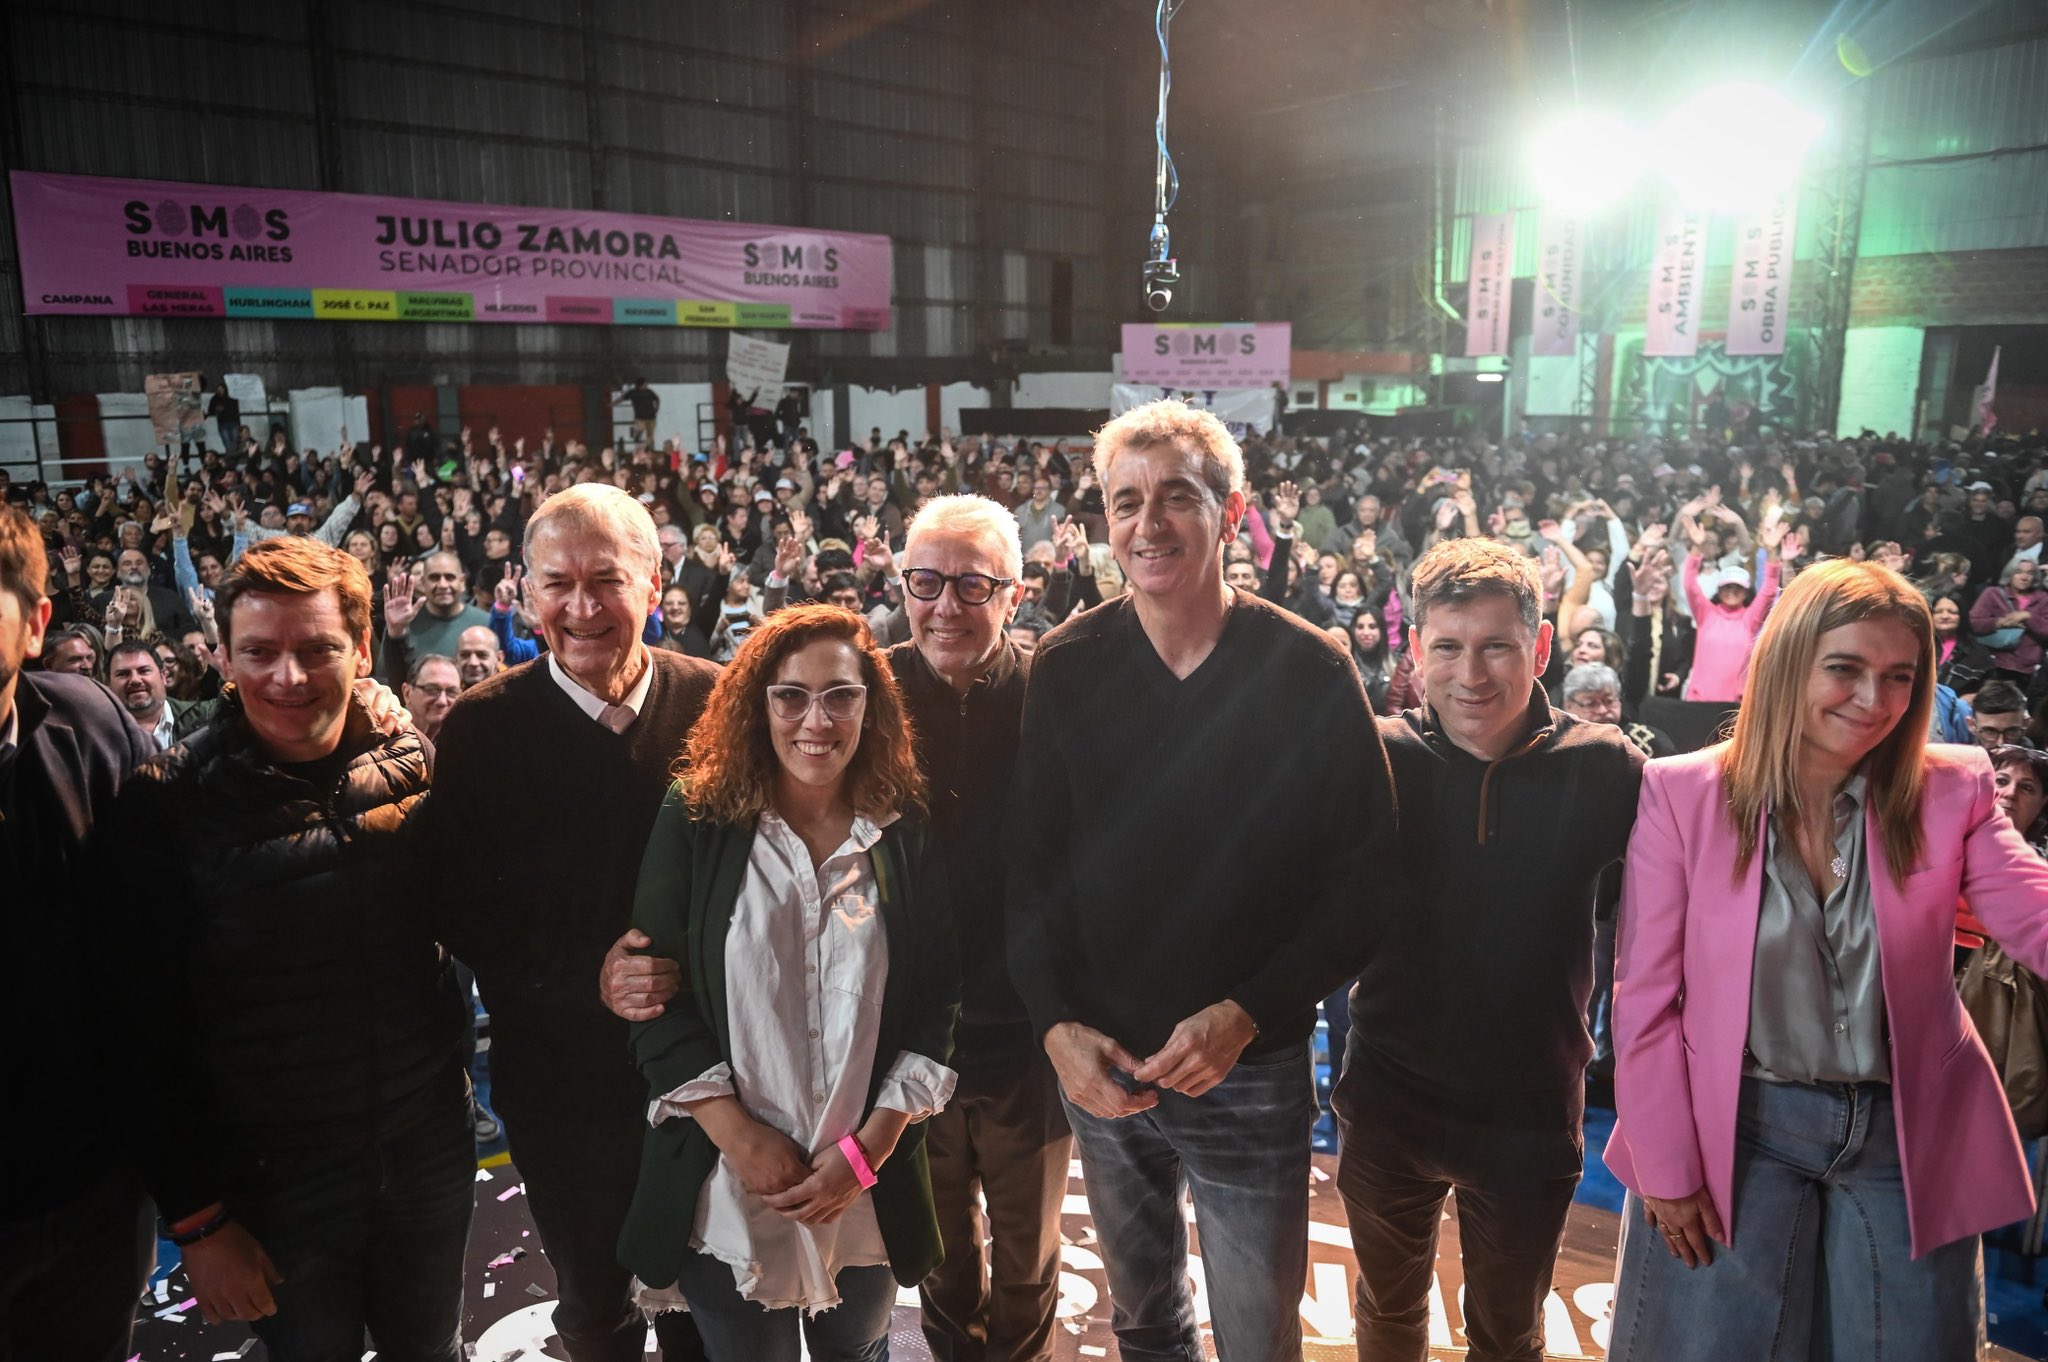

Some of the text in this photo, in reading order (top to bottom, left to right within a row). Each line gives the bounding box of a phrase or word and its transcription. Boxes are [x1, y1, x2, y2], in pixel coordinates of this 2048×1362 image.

[376, 216, 681, 260] JULIO ZAMORA
[127, 240, 293, 263] BUENOS AIRES
[379, 250, 685, 284] SENADOR PROVINCIAL
[744, 271, 839, 289] BUENOS AIRES
[41, 294, 114, 305] CAMPANA
[368, 301, 390, 312] PAZ
[1761, 286, 1777, 344] OBRA
